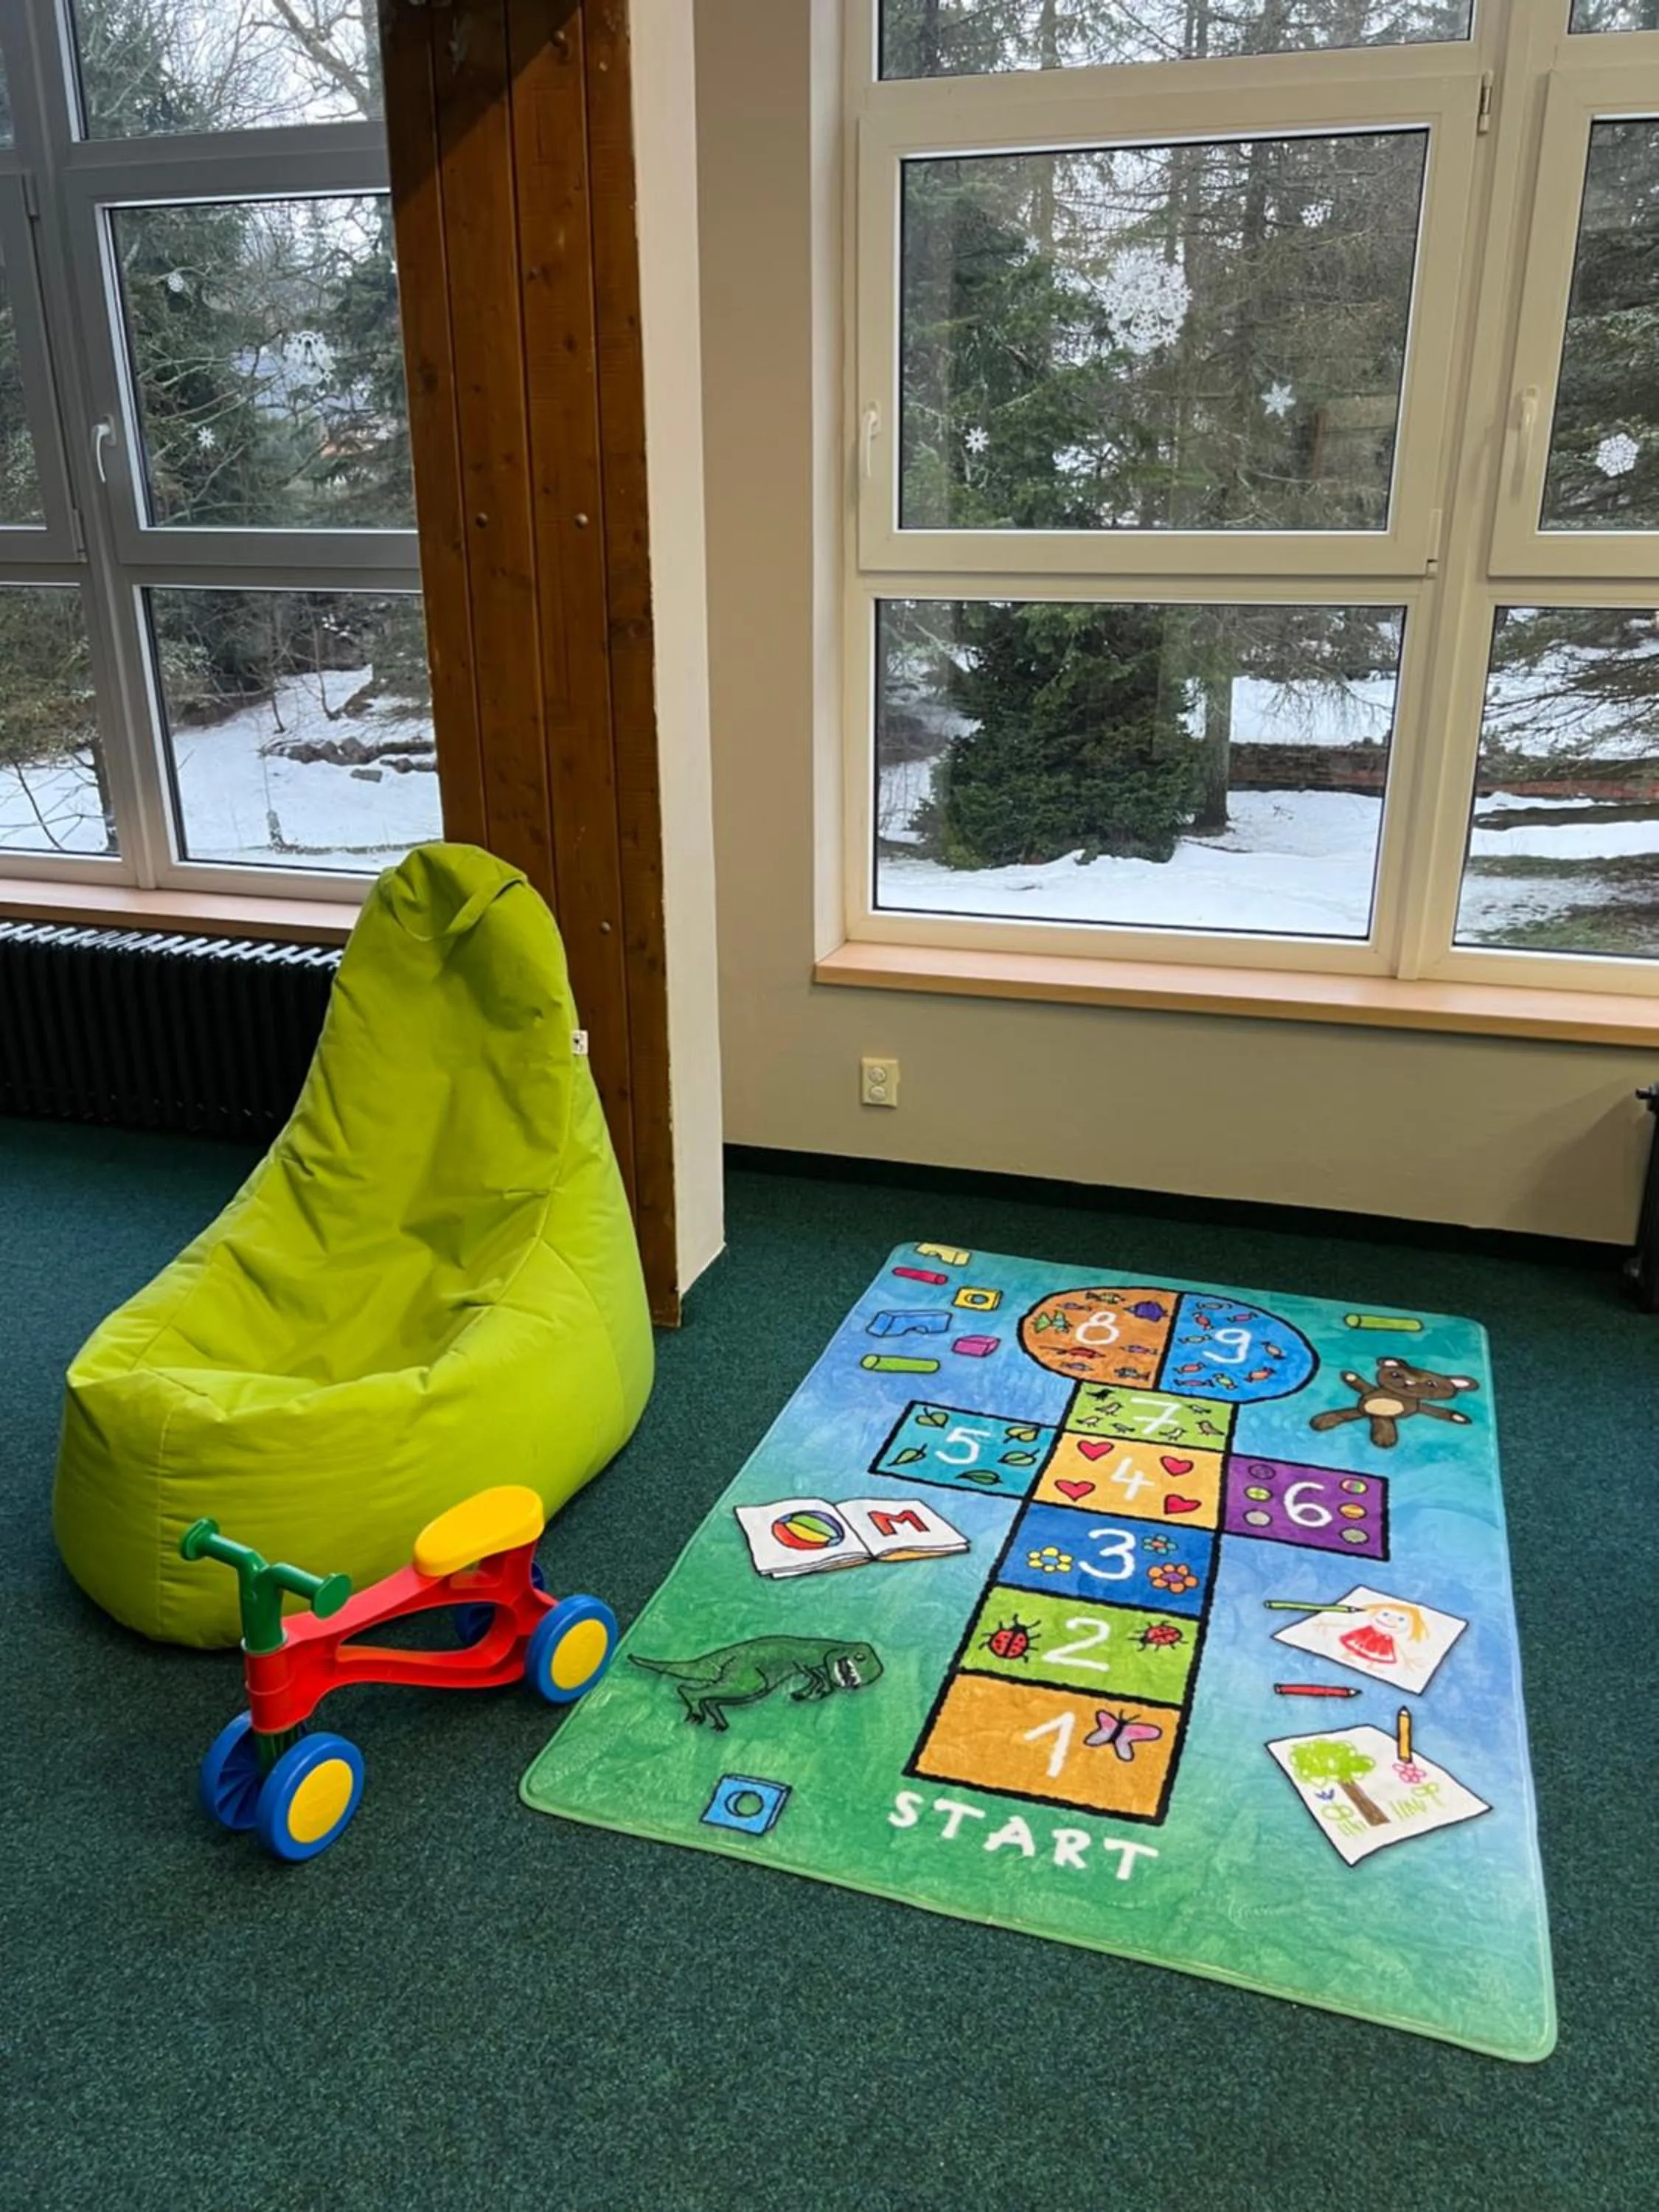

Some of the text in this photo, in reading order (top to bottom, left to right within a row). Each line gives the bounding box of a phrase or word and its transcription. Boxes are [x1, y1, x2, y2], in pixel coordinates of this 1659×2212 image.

[1075, 1311, 1119, 1346] 8
[1203, 1328, 1251, 1364] 9
[1130, 1397, 1183, 1435] 7
[935, 1427, 991, 1464] 5
[1110, 1457, 1155, 1500] 4
[867, 1509, 931, 1537] M
[1284, 1481, 1333, 1527] 6
[1078, 1528, 1136, 1580] 3
[1042, 1616, 1110, 1672] 2
[1023, 1711, 1075, 1779] 1
[887, 1790, 1160, 1881] START
